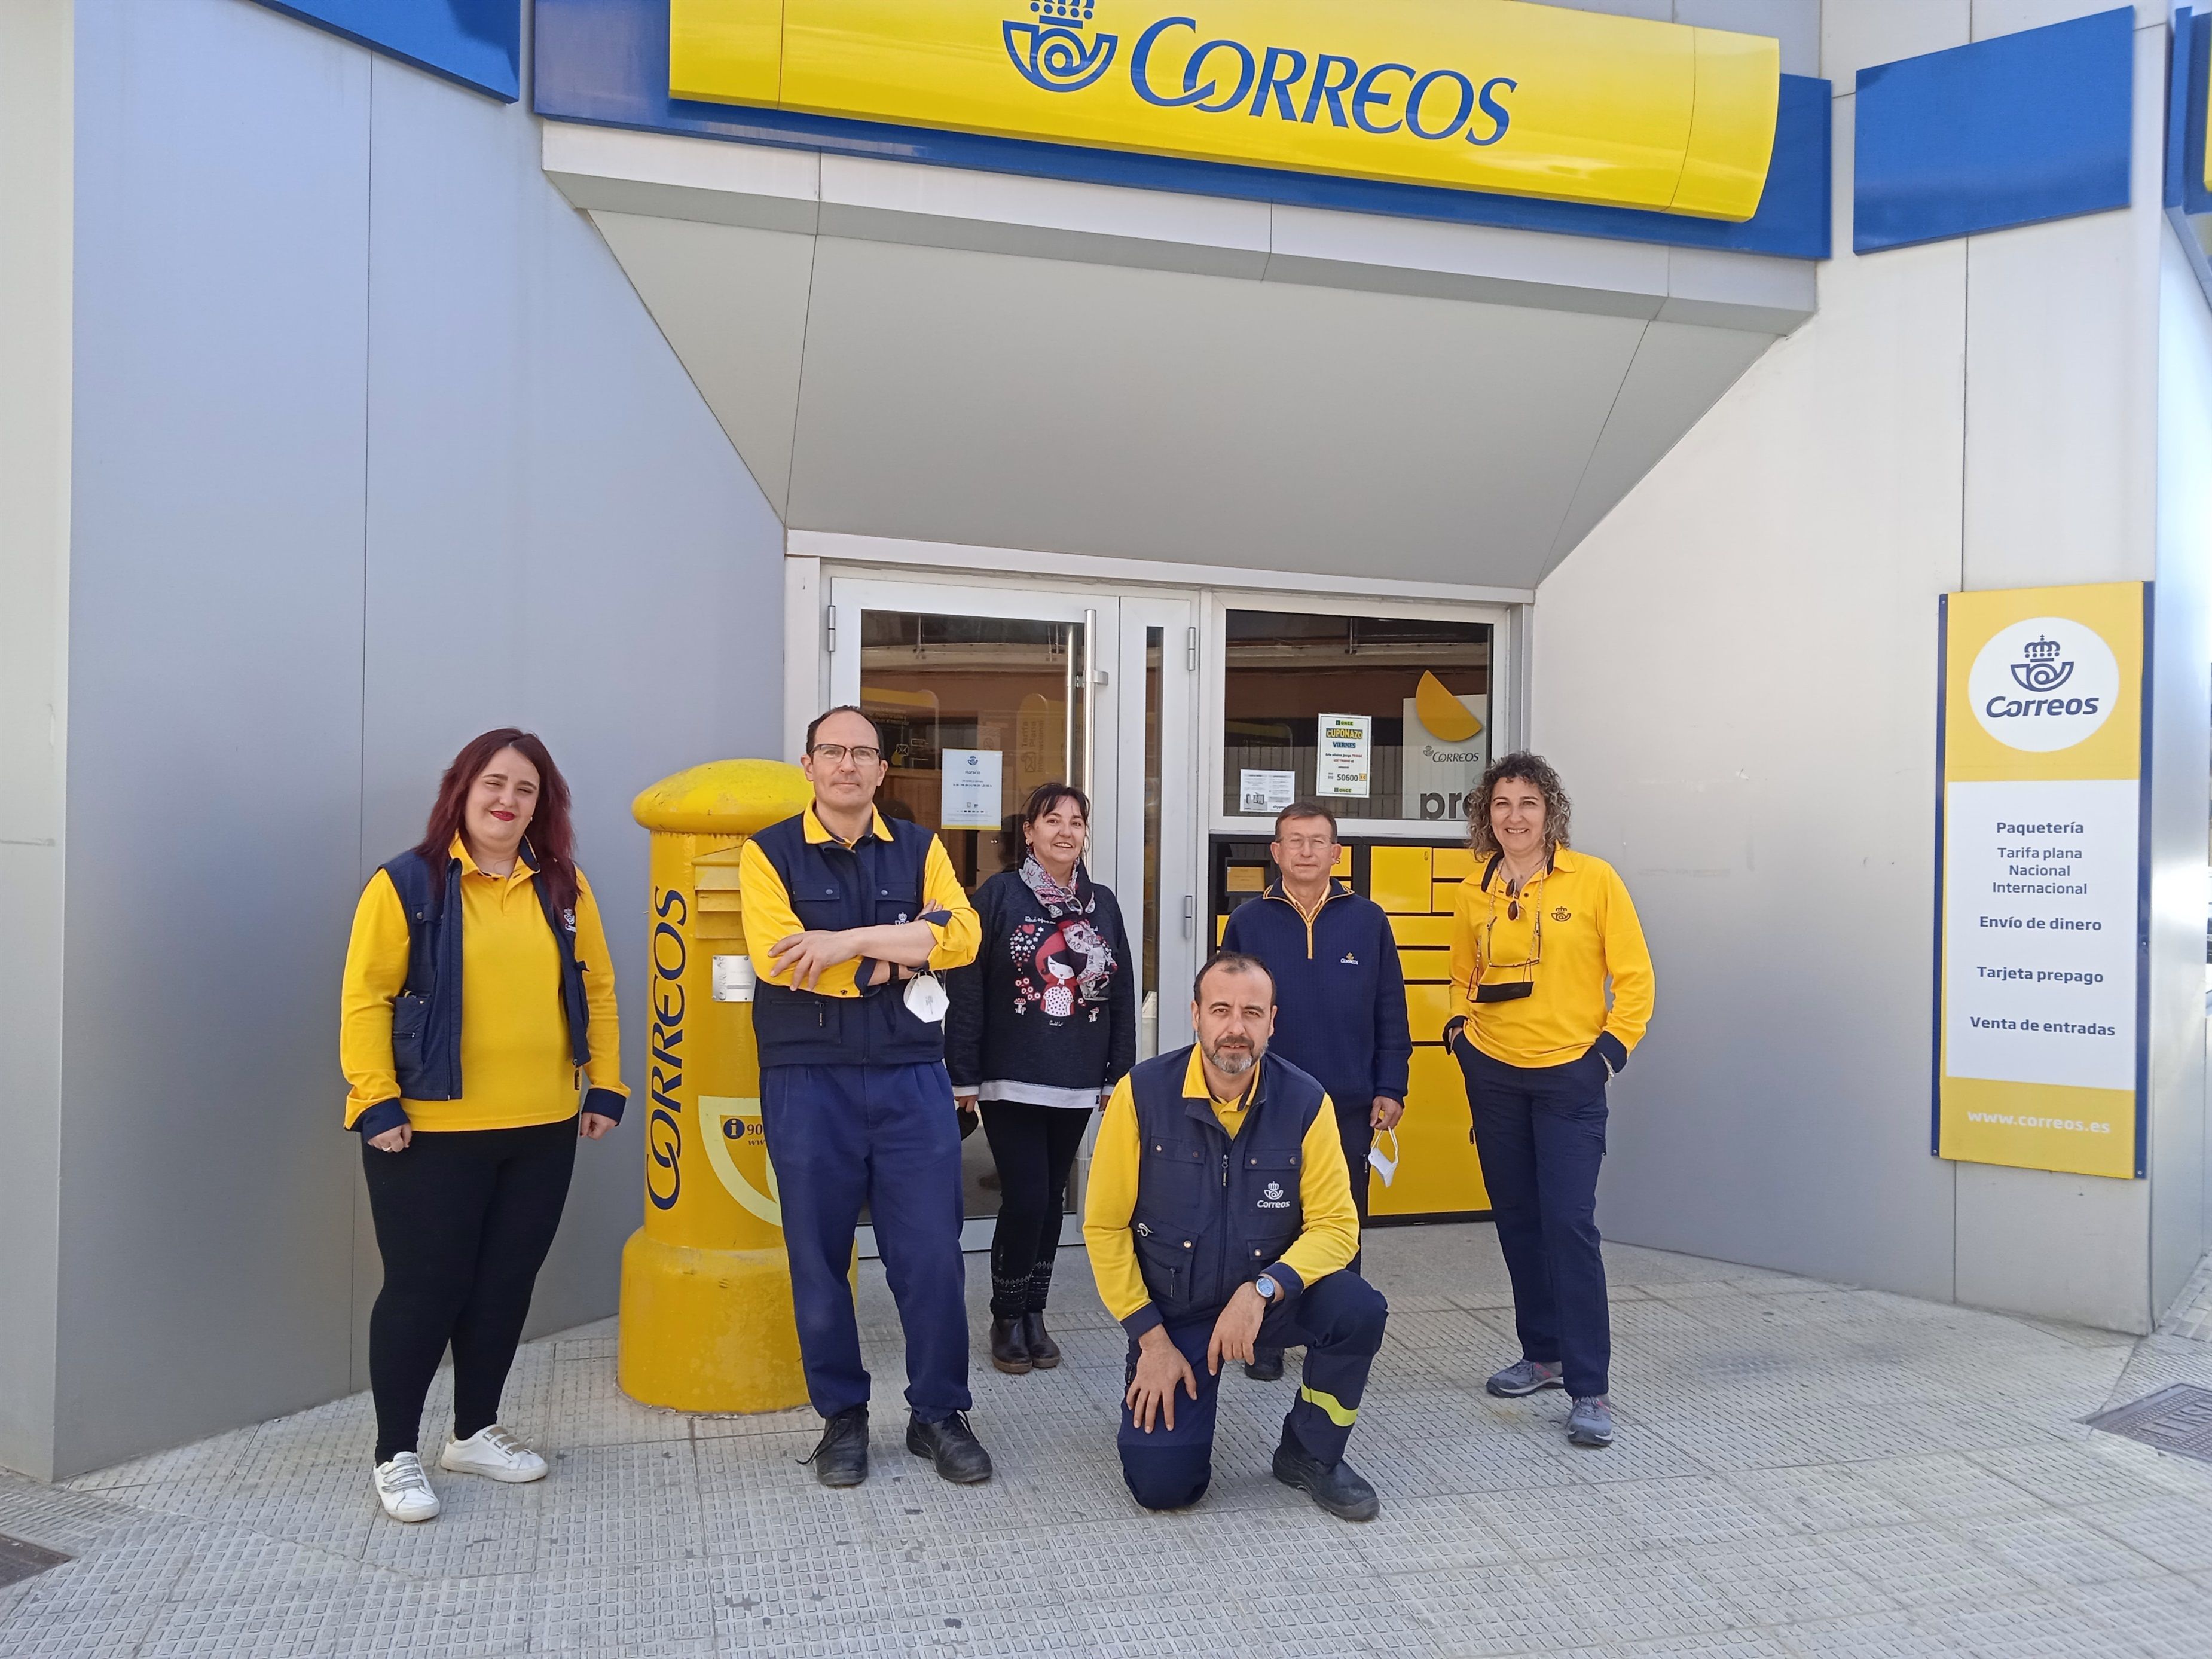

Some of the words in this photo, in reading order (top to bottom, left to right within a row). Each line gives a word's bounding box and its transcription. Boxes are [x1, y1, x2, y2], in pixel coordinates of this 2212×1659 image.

[1130, 16, 1519, 146] CORREOS
[1986, 696, 2100, 718] Correos
[1327, 729, 1362, 739] CUPONAZO
[1432, 751, 1479, 762] CORREOS
[1997, 821, 2083, 836] Paquetería
[1997, 847, 2039, 858] Tarifa
[2043, 847, 2082, 861] plana
[2009, 864, 2070, 876] Nacional
[1993, 882, 2087, 894] Internacional
[1980, 916, 2022, 928] Envío
[2026, 917, 2046, 929] de
[2049, 918, 2101, 931] dinero
[1976, 966, 2033, 981] Tarjeta
[2037, 971, 2103, 985] prepago
[1970, 1016, 2016, 1030] Venta
[2020, 1019, 2039, 1031] de
[2043, 1022, 2115, 1036] entradas
[647, 885, 687, 1211] CORREOS
[1967, 1110, 2111, 1134] www.correos.es
[1257, 1200, 1291, 1208] Correos
